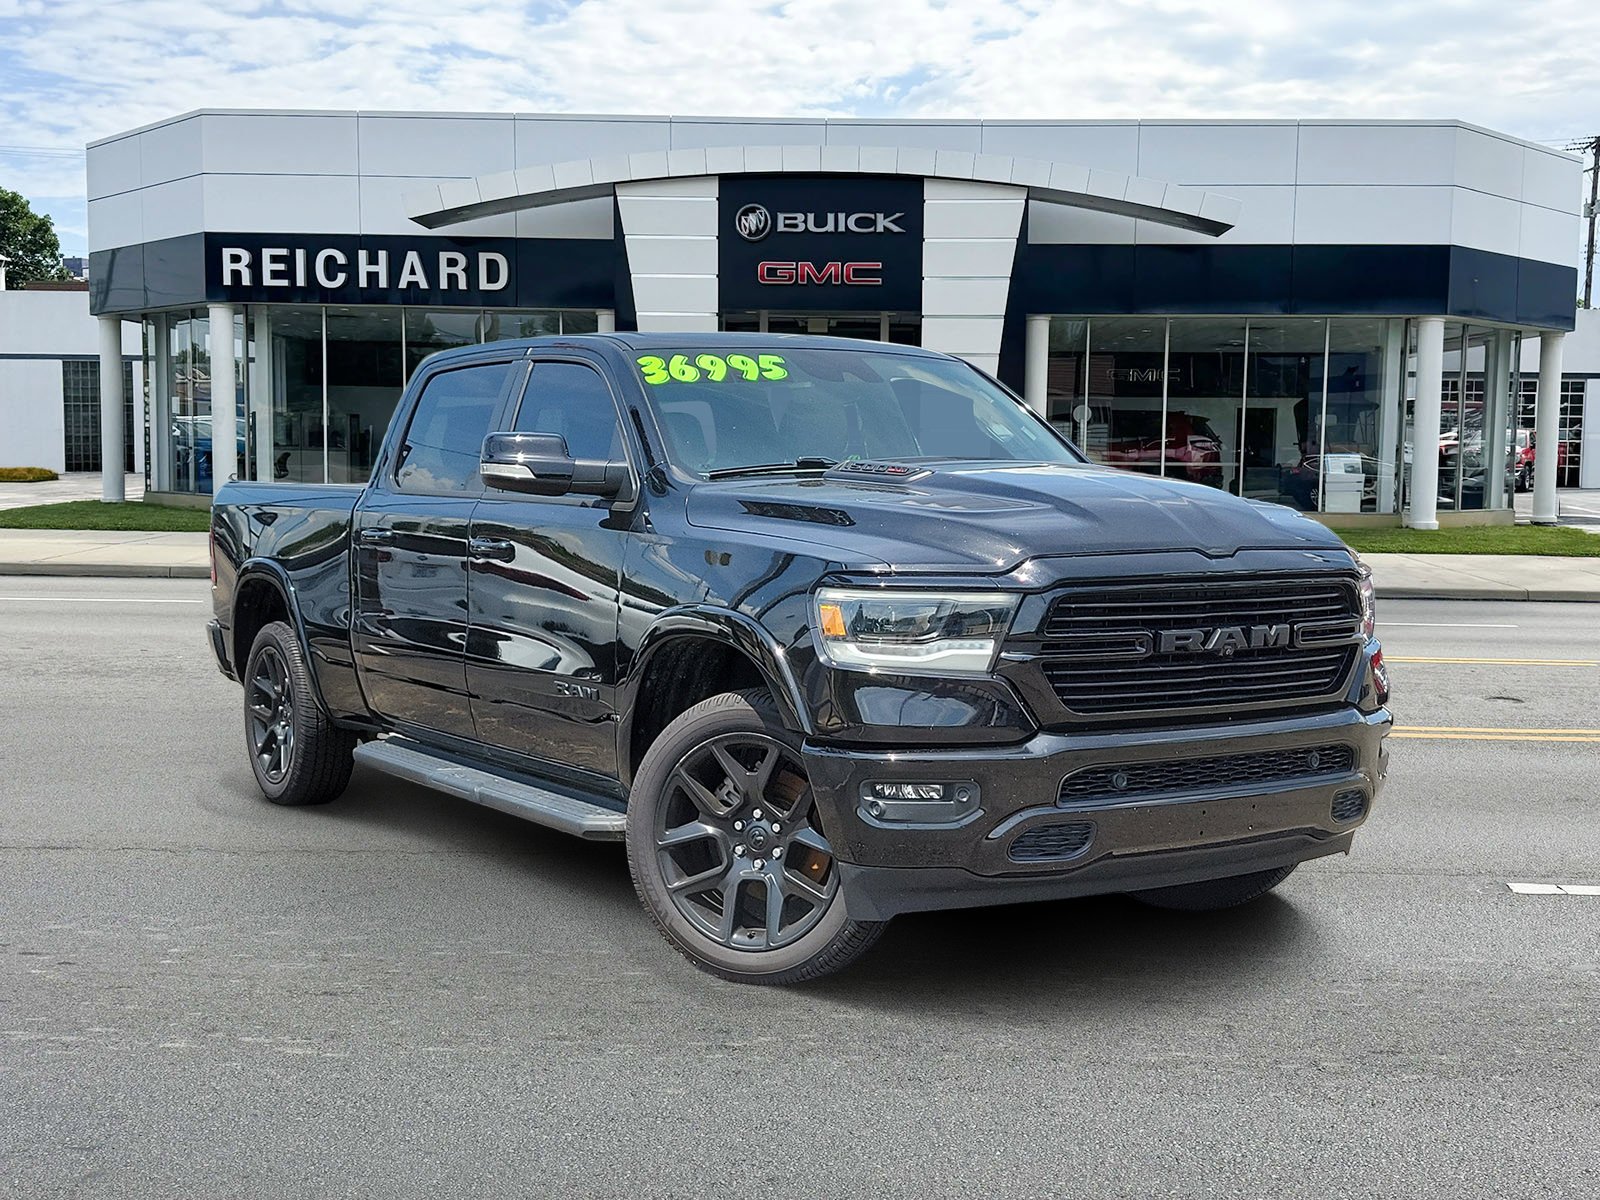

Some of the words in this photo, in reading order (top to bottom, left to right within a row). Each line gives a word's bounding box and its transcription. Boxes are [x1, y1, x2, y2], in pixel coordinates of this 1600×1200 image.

[776, 211, 906, 233] BUICK
[221, 247, 510, 291] REICHARD
[757, 261, 883, 285] GMC
[637, 353, 788, 385] 36995
[1157, 623, 1291, 654] RAM
